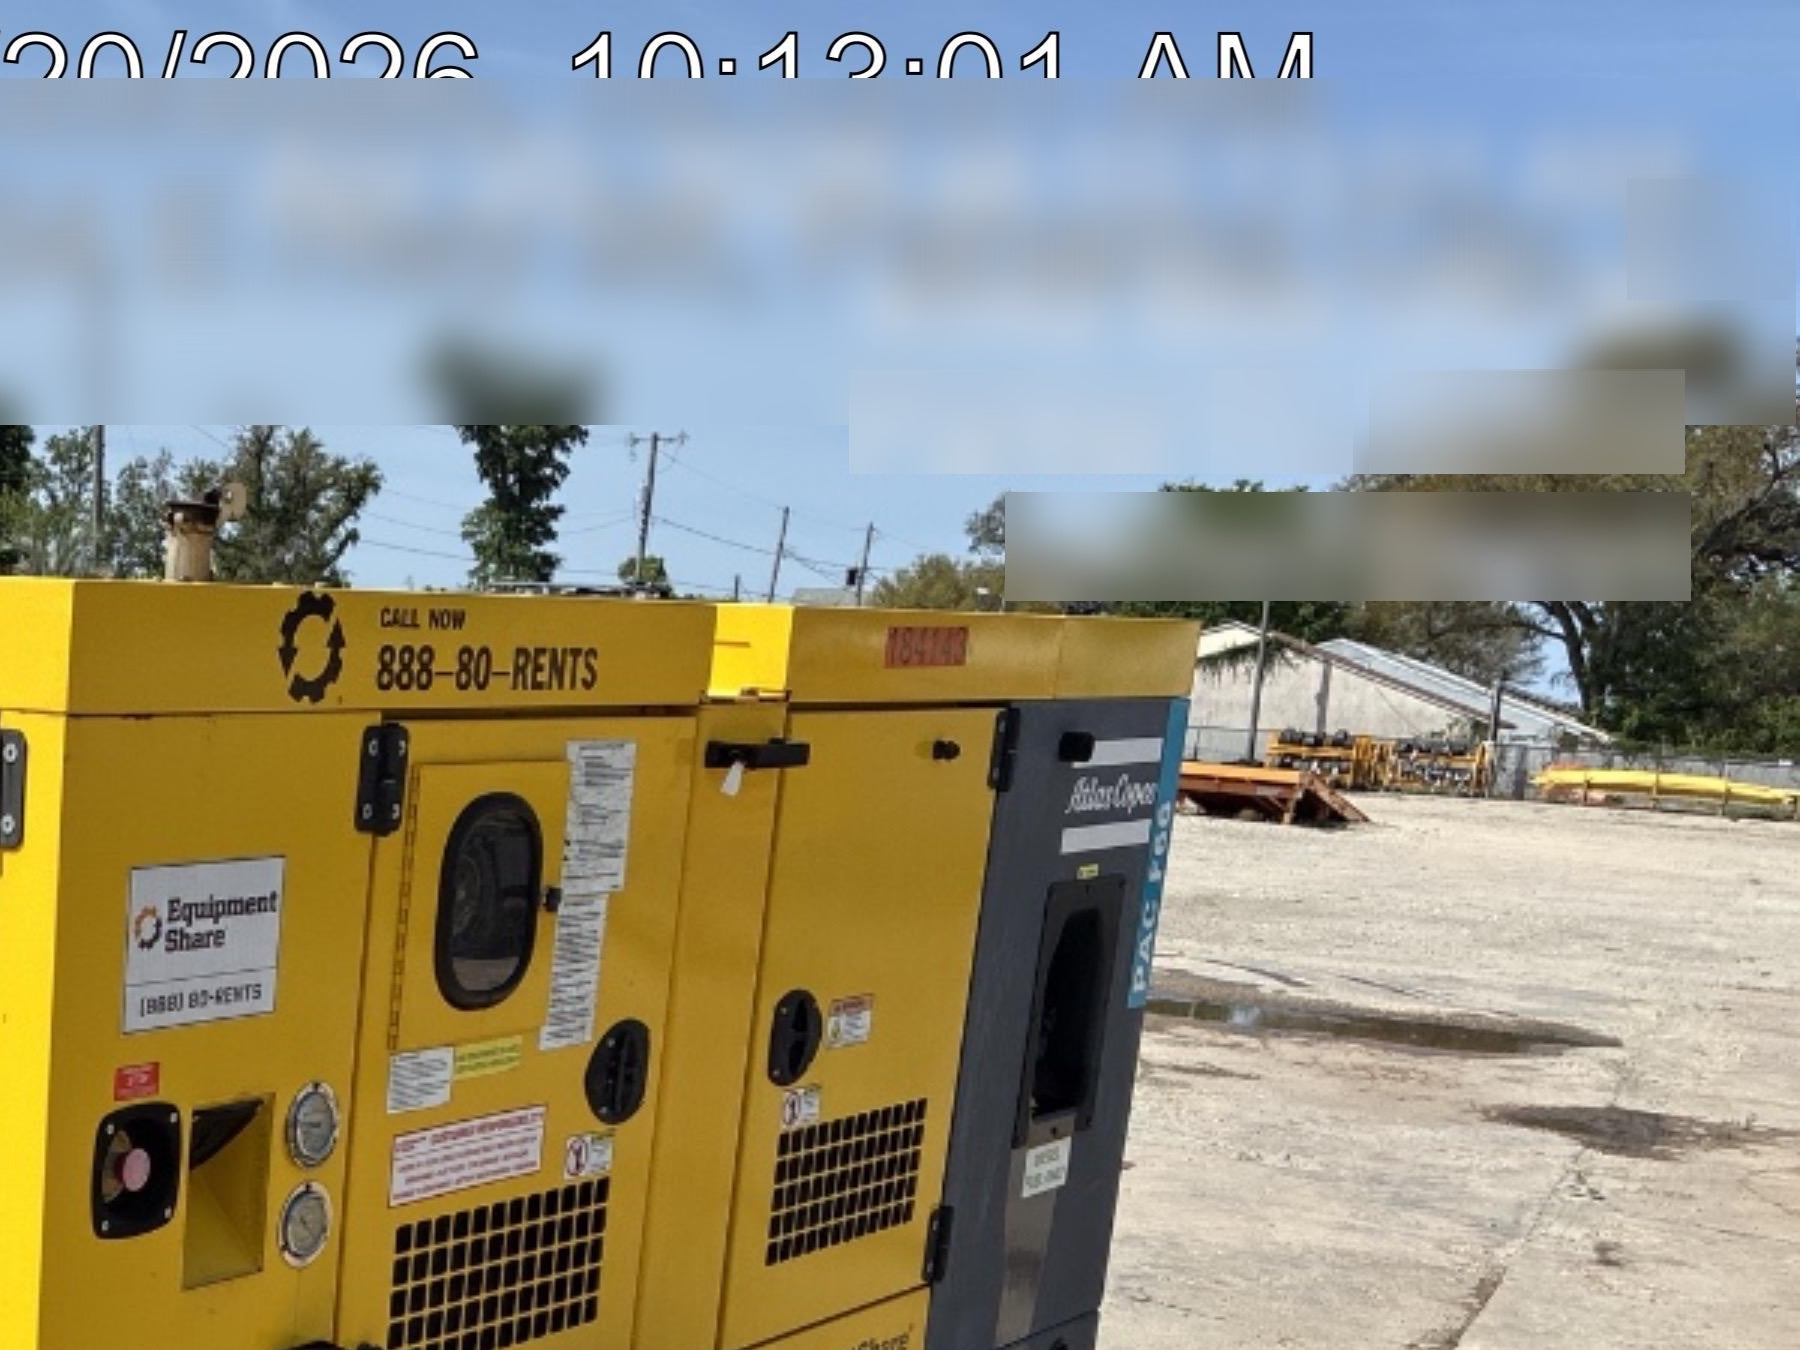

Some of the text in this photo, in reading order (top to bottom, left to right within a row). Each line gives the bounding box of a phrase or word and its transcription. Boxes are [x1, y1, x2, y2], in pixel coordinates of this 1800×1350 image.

[381, 607, 466, 630] CALL NOW
[376, 645, 599, 691] 888-80-RENTS
[1064, 776, 1114, 814] Atlas
[167, 890, 278, 928] Equipment
[164, 927, 226, 952] Share
[1133, 900, 1156, 992] PAC
